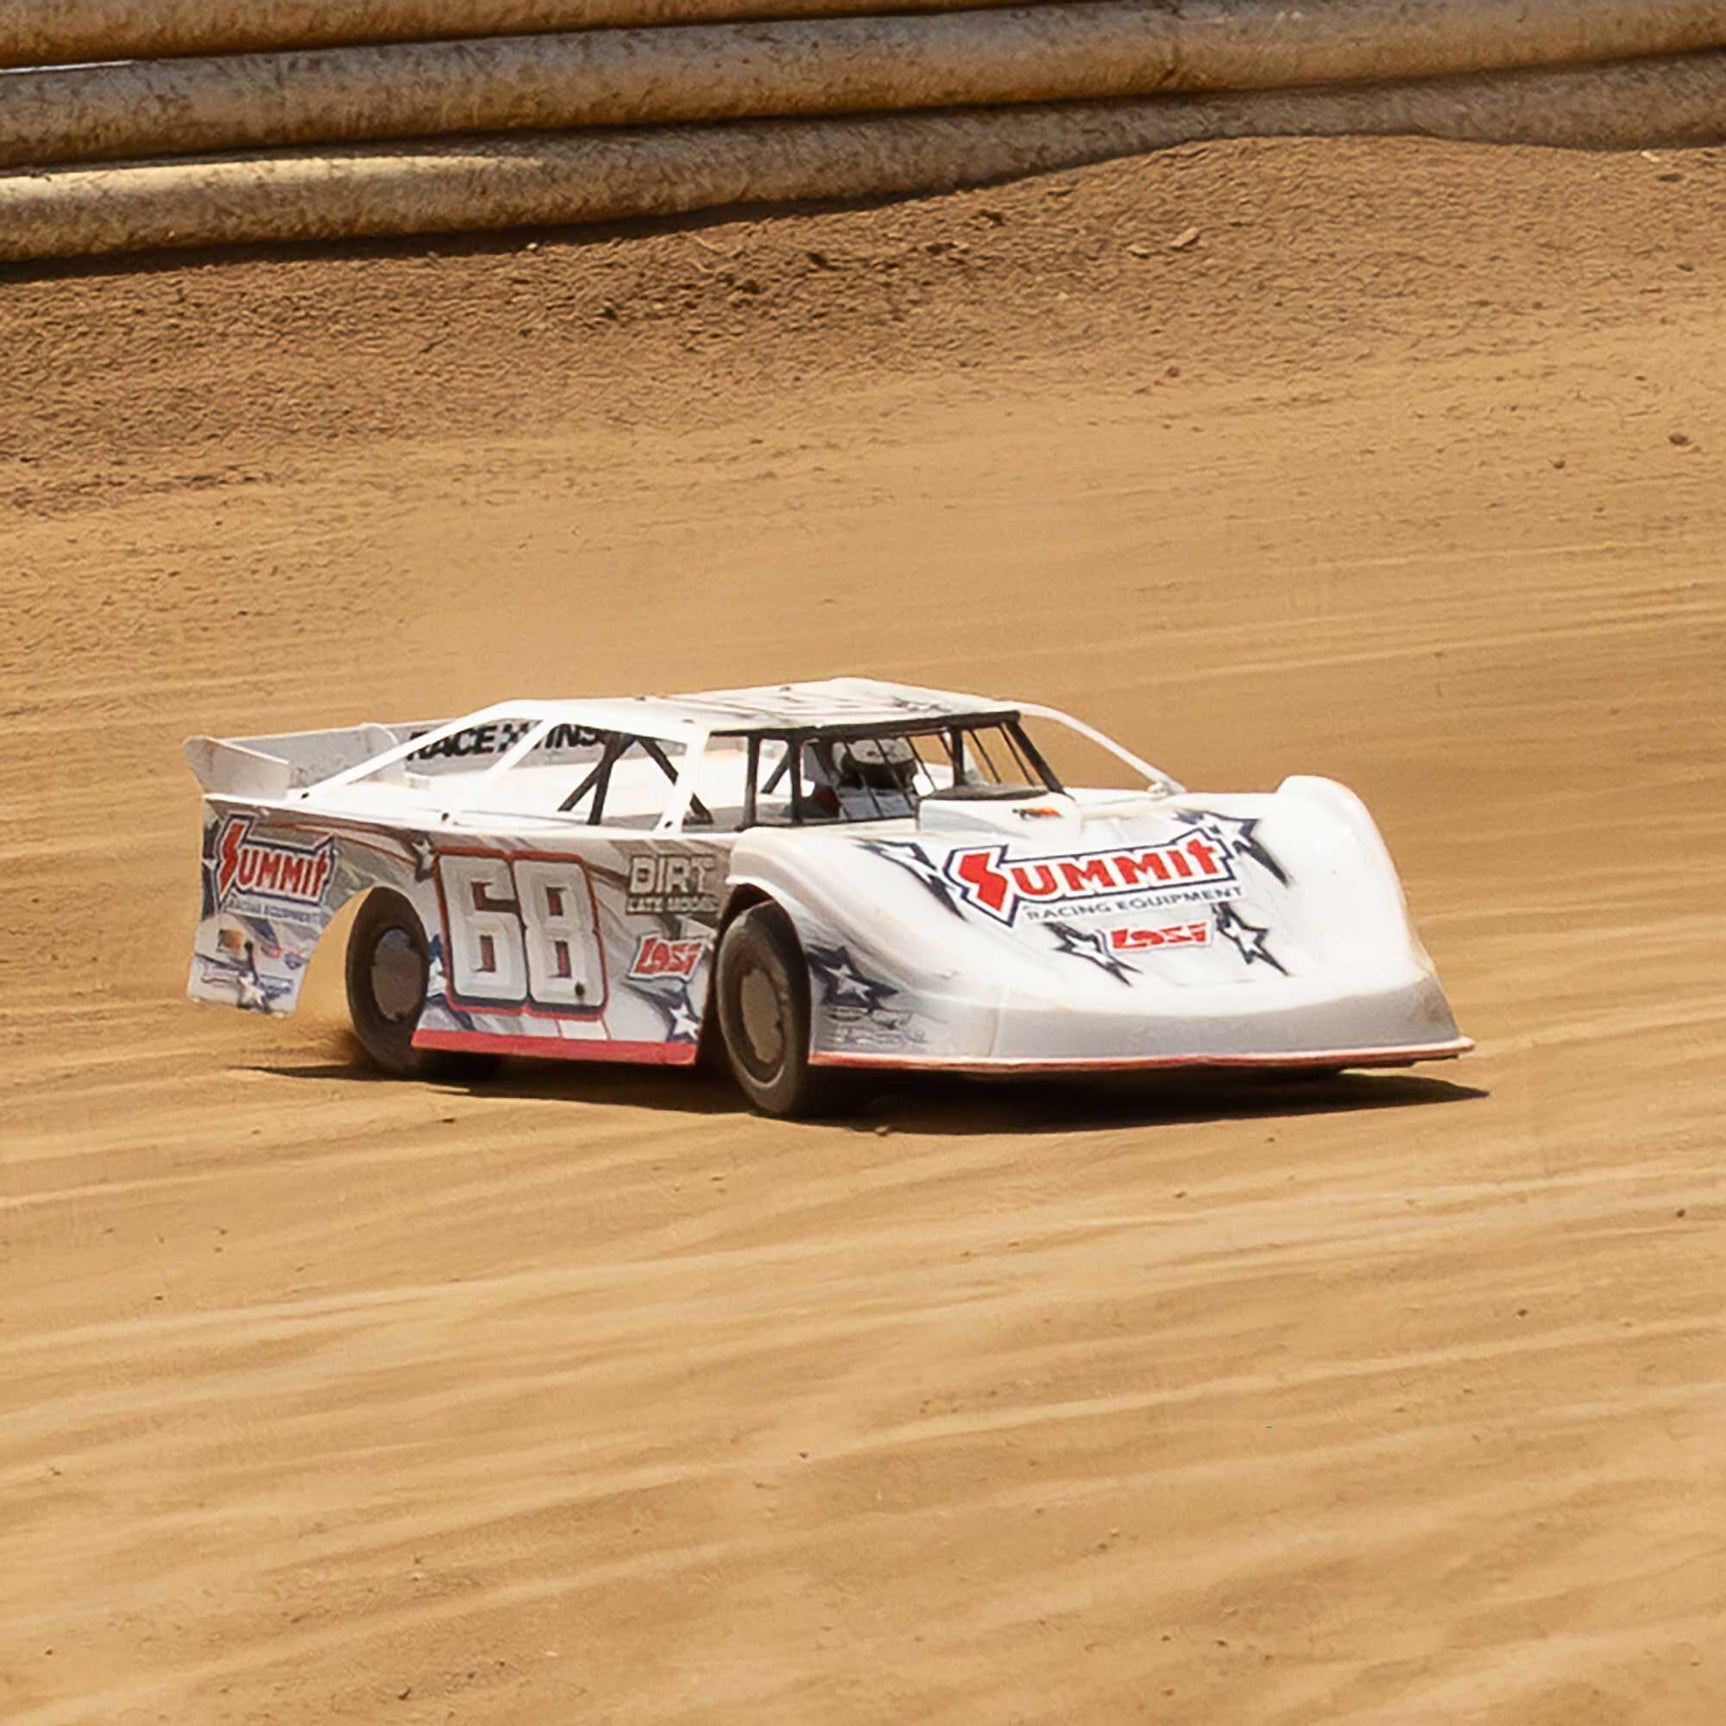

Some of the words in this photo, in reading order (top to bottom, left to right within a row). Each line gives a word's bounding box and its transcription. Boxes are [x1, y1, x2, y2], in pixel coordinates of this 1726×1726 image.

[629, 855, 715, 895] DIRT
[1025, 902, 1111, 922] RACING
[1116, 886, 1244, 912] EQUIPMENT
[437, 852, 606, 1010] 68
